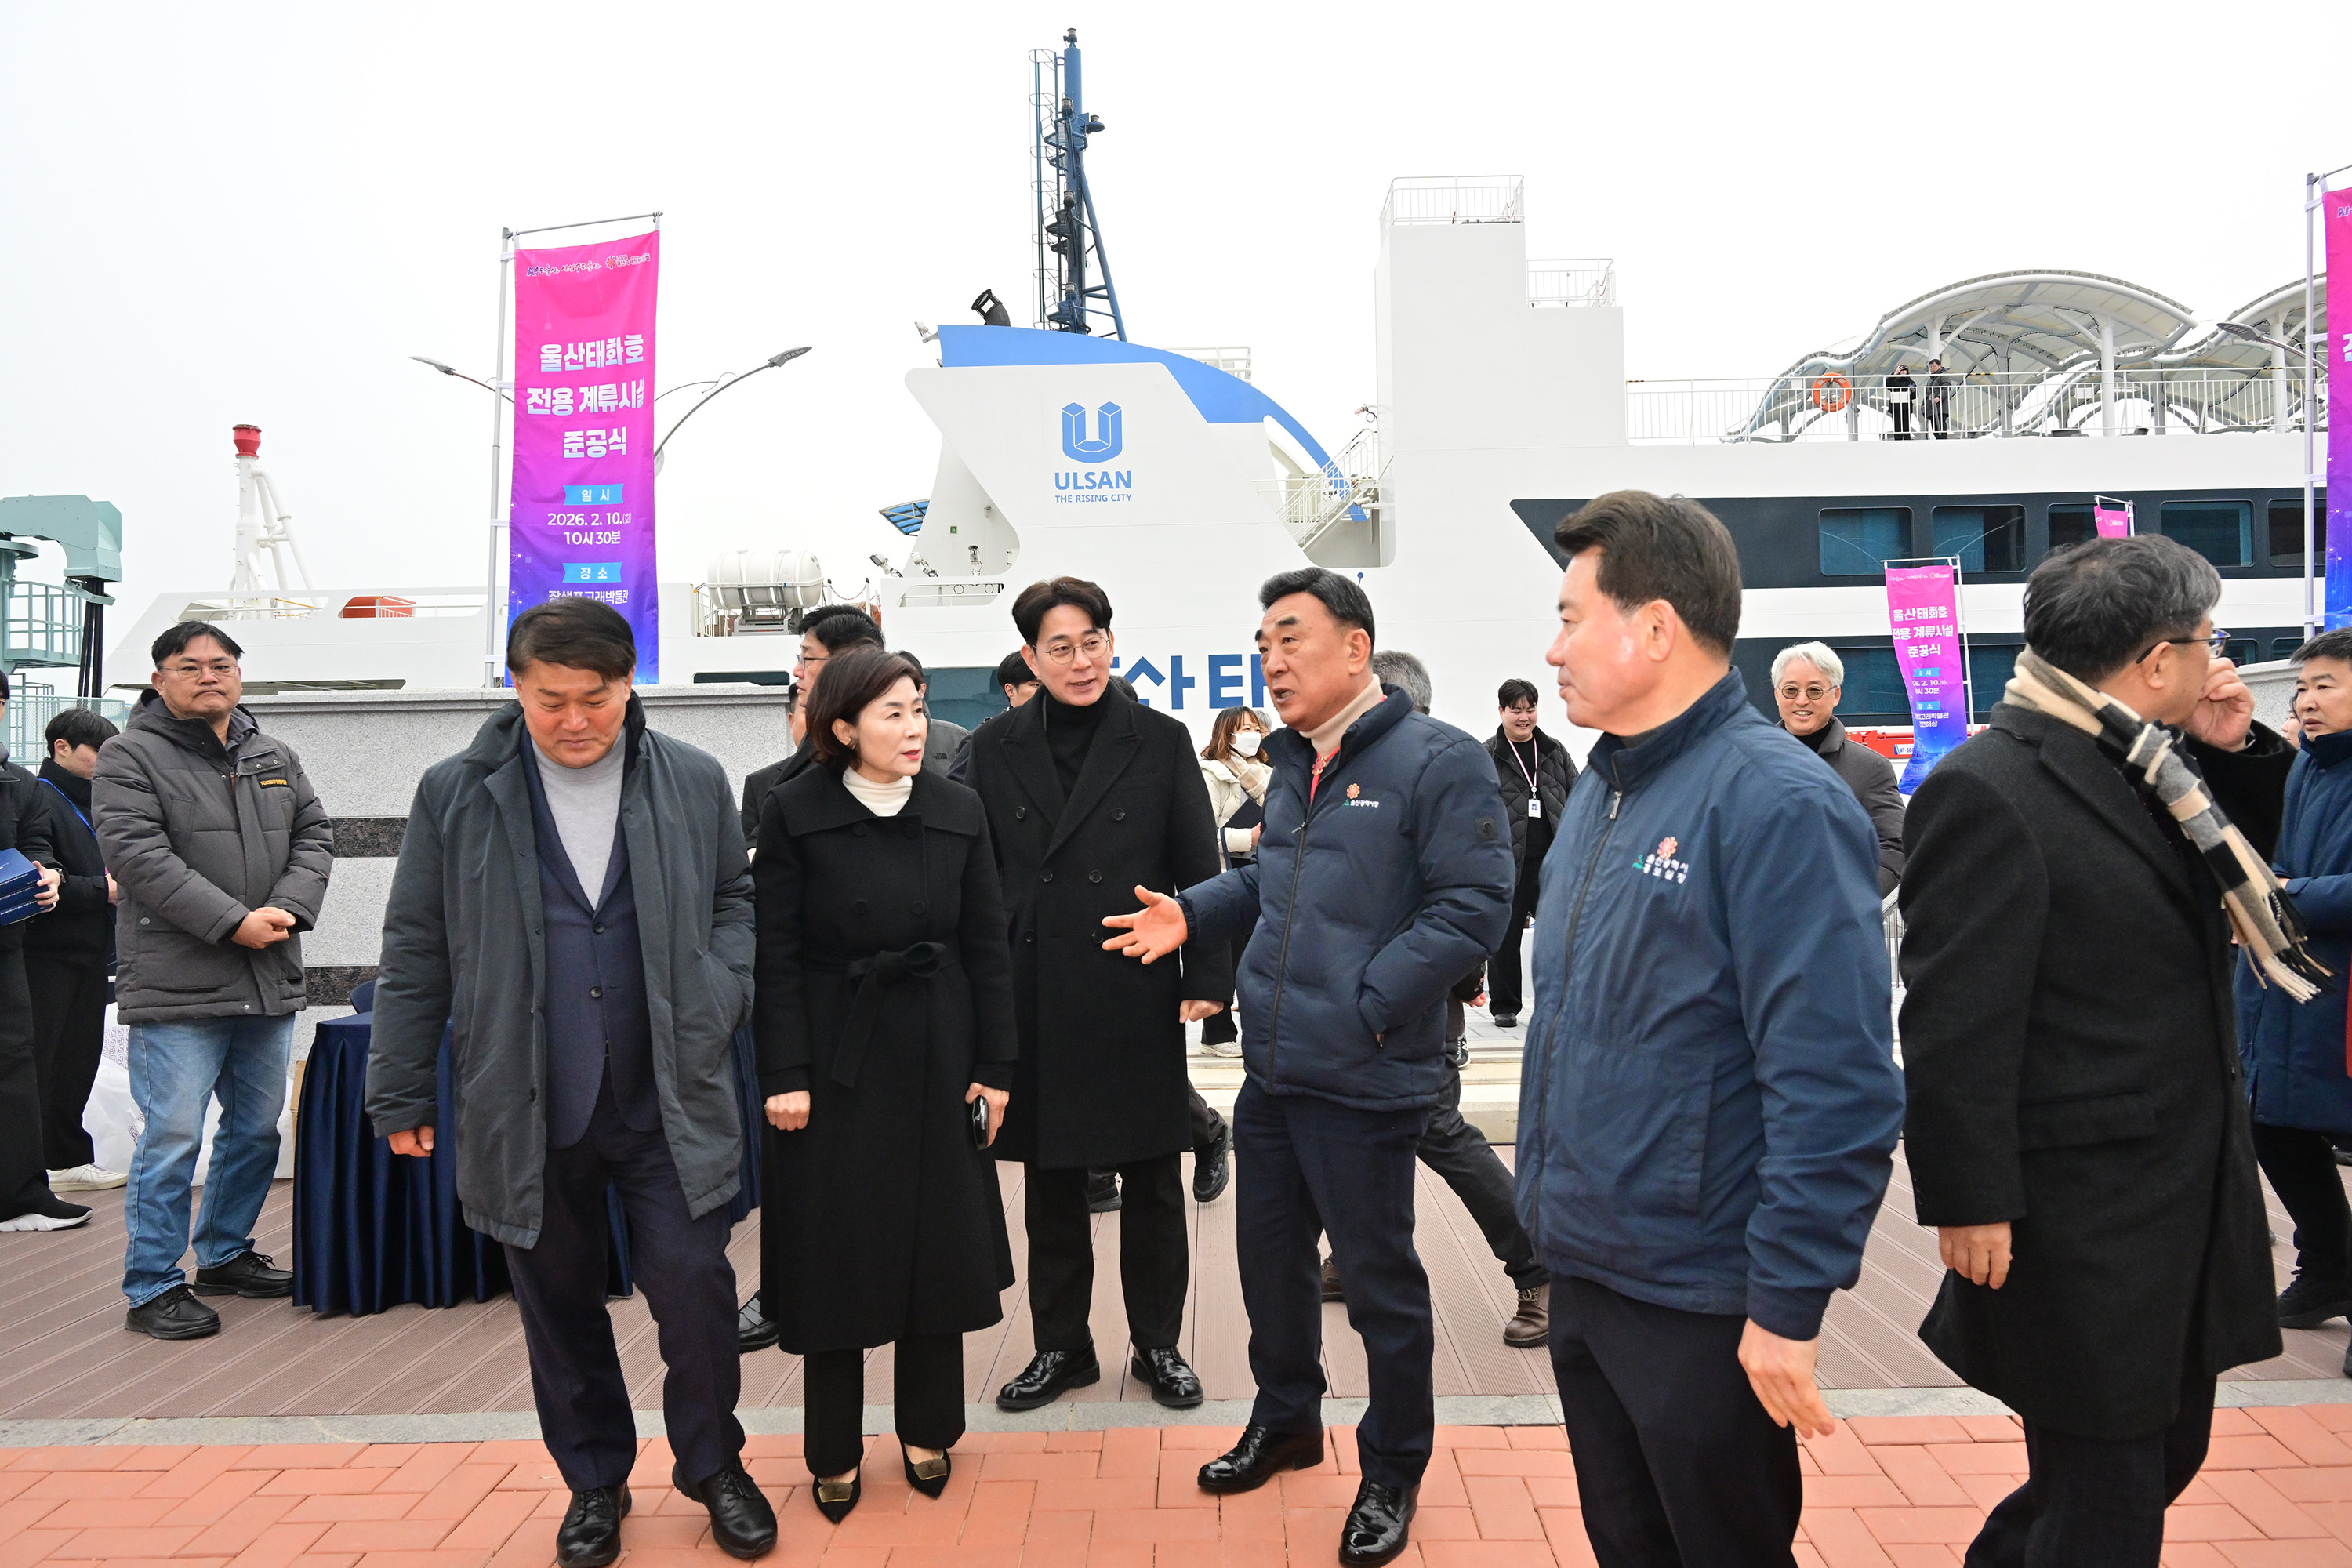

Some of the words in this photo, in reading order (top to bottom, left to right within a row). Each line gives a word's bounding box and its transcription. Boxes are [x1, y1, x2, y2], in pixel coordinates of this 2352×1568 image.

[540, 334, 644, 372] 울산태화호
[526, 387, 574, 416] 전용
[564, 426, 627, 458] 준공식
[1054, 470, 1132, 490] ULSAN
[582, 489, 592, 502] 일
[600, 488, 610, 501] 시
[1054, 495, 1073, 503] THE
[1075, 494, 1108, 503] RISING
[1111, 493, 1132, 502] CITY
[547, 514, 588, 526] 2026.
[590, 514, 602, 525] 2.
[564, 531, 593, 545] 10시
[595, 530, 621, 544] 30분
[580, 567, 591, 579] 장
[597, 567, 608, 579] 소
[1893, 606, 1948, 622] 울산태화호
[1892, 627, 1911, 640] 전용
[1913, 624, 1953, 638] 계류시설
[1907, 644, 1941, 658] 준공식
